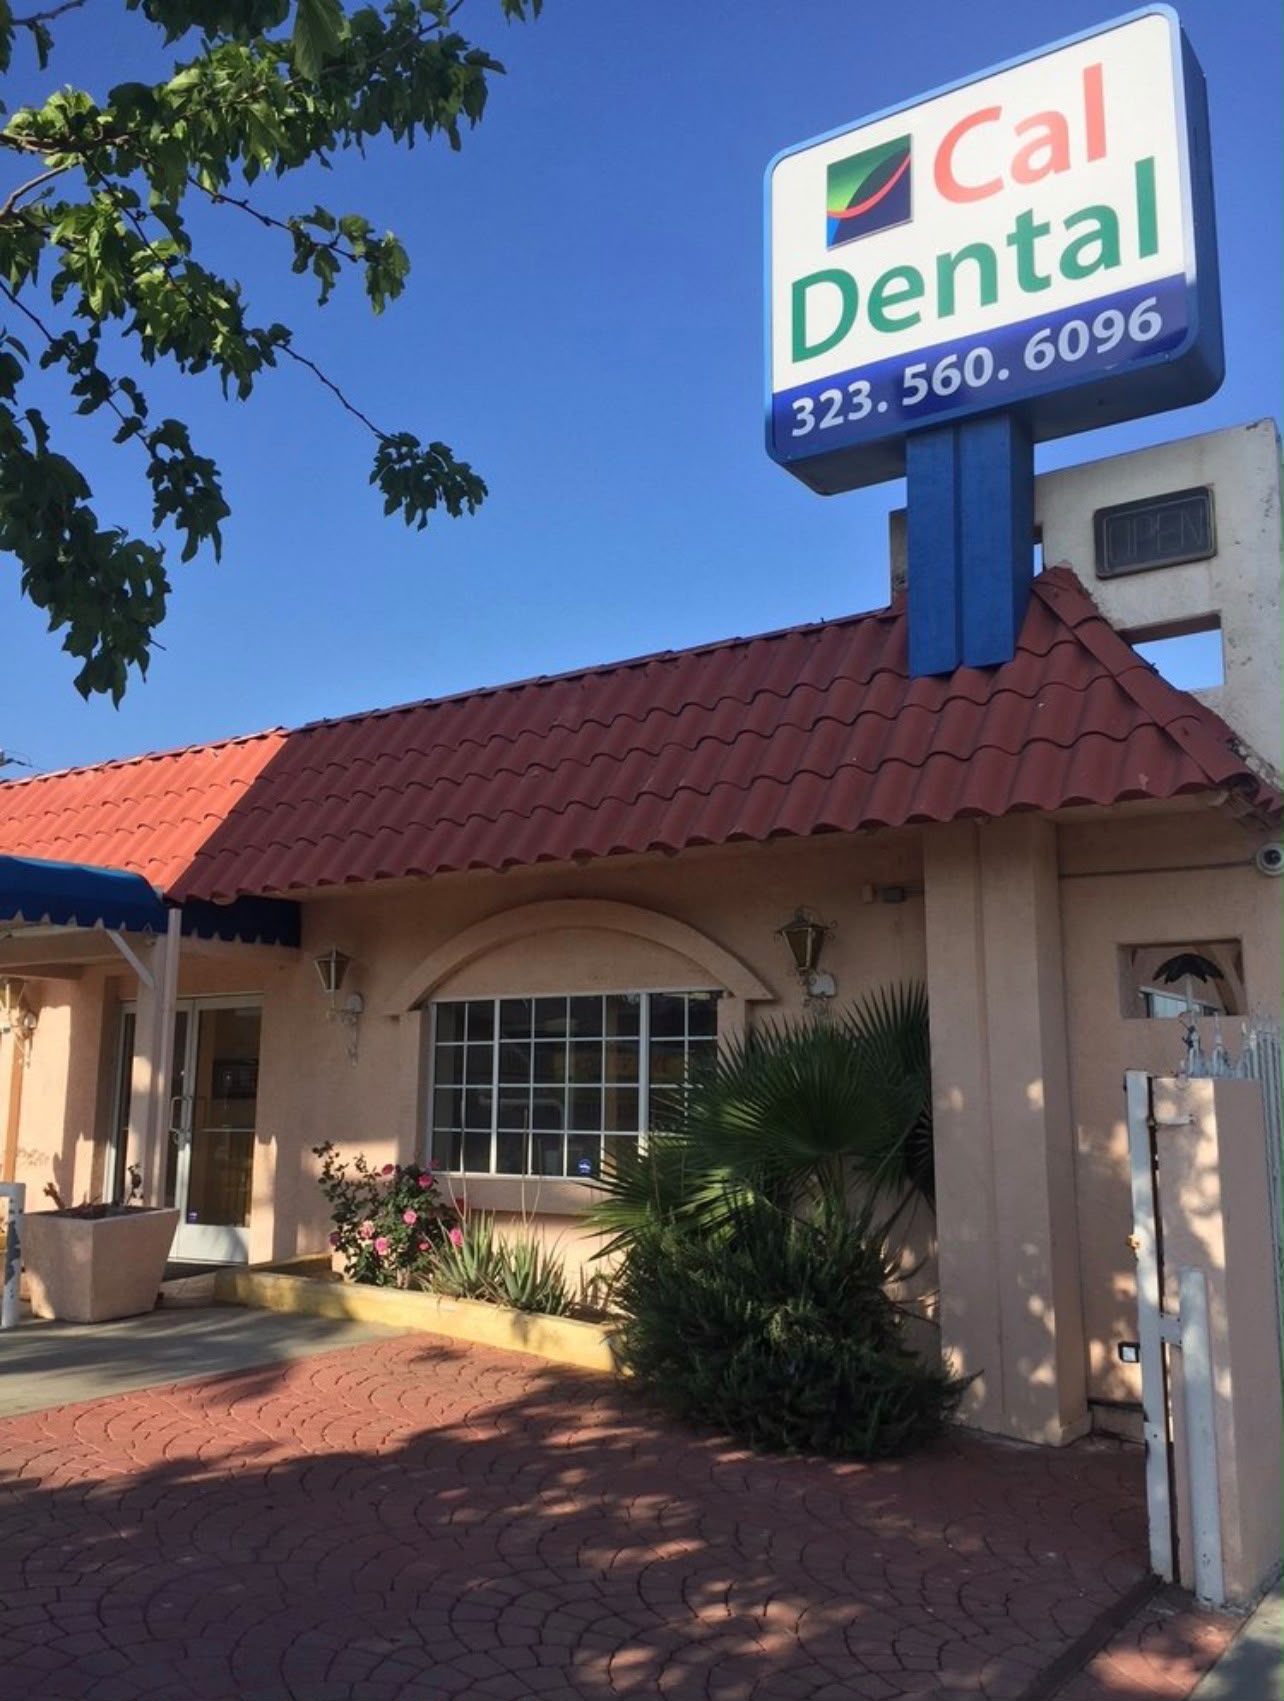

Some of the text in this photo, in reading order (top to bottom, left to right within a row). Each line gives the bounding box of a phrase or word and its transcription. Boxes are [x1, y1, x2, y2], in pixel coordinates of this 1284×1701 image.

[933, 63, 1107, 205] Cal
[791, 156, 1159, 364] Dental
[791, 297, 1162, 437] 323. 560. 6096
